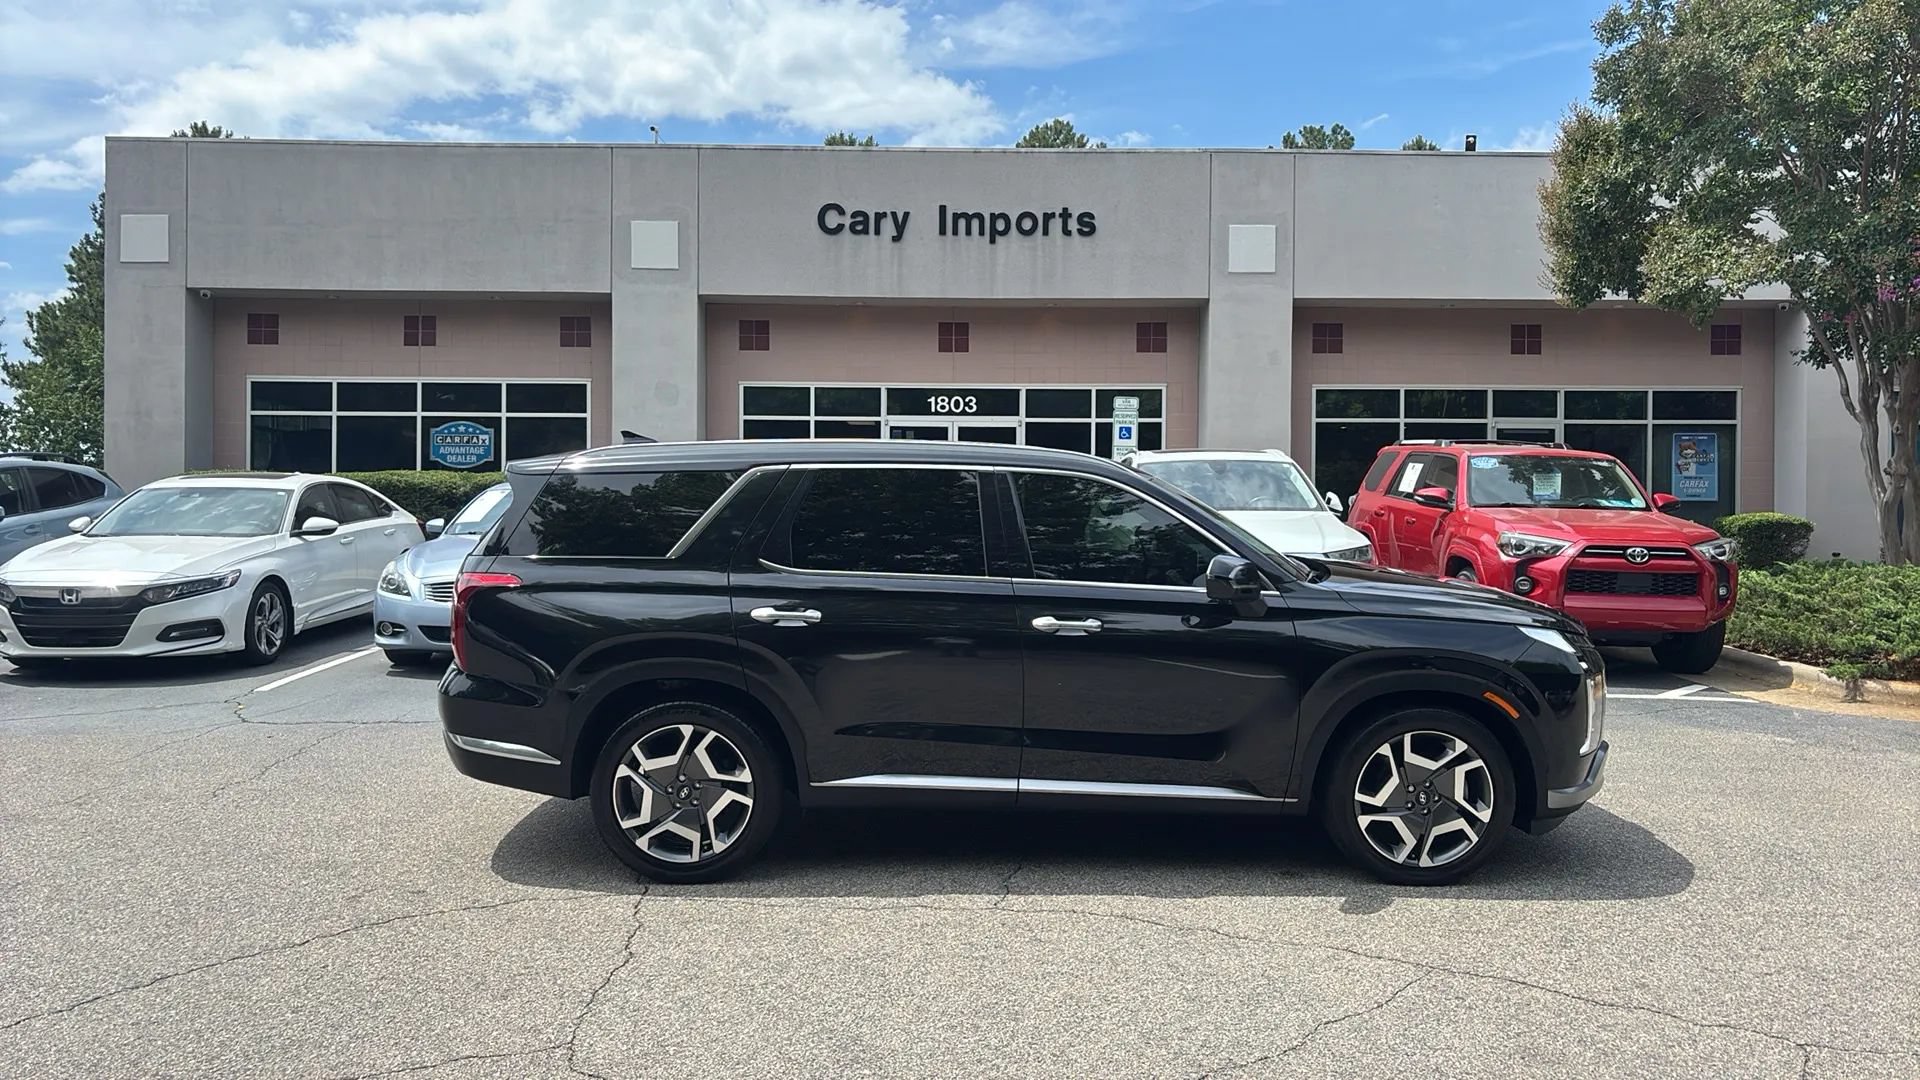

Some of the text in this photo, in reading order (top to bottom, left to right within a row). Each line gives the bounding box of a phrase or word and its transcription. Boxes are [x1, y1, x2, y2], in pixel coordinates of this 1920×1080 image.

[817, 203, 1097, 244] Cary Imports
[927, 395, 977, 413] 1803
[436, 436, 487, 444] CARFAX
